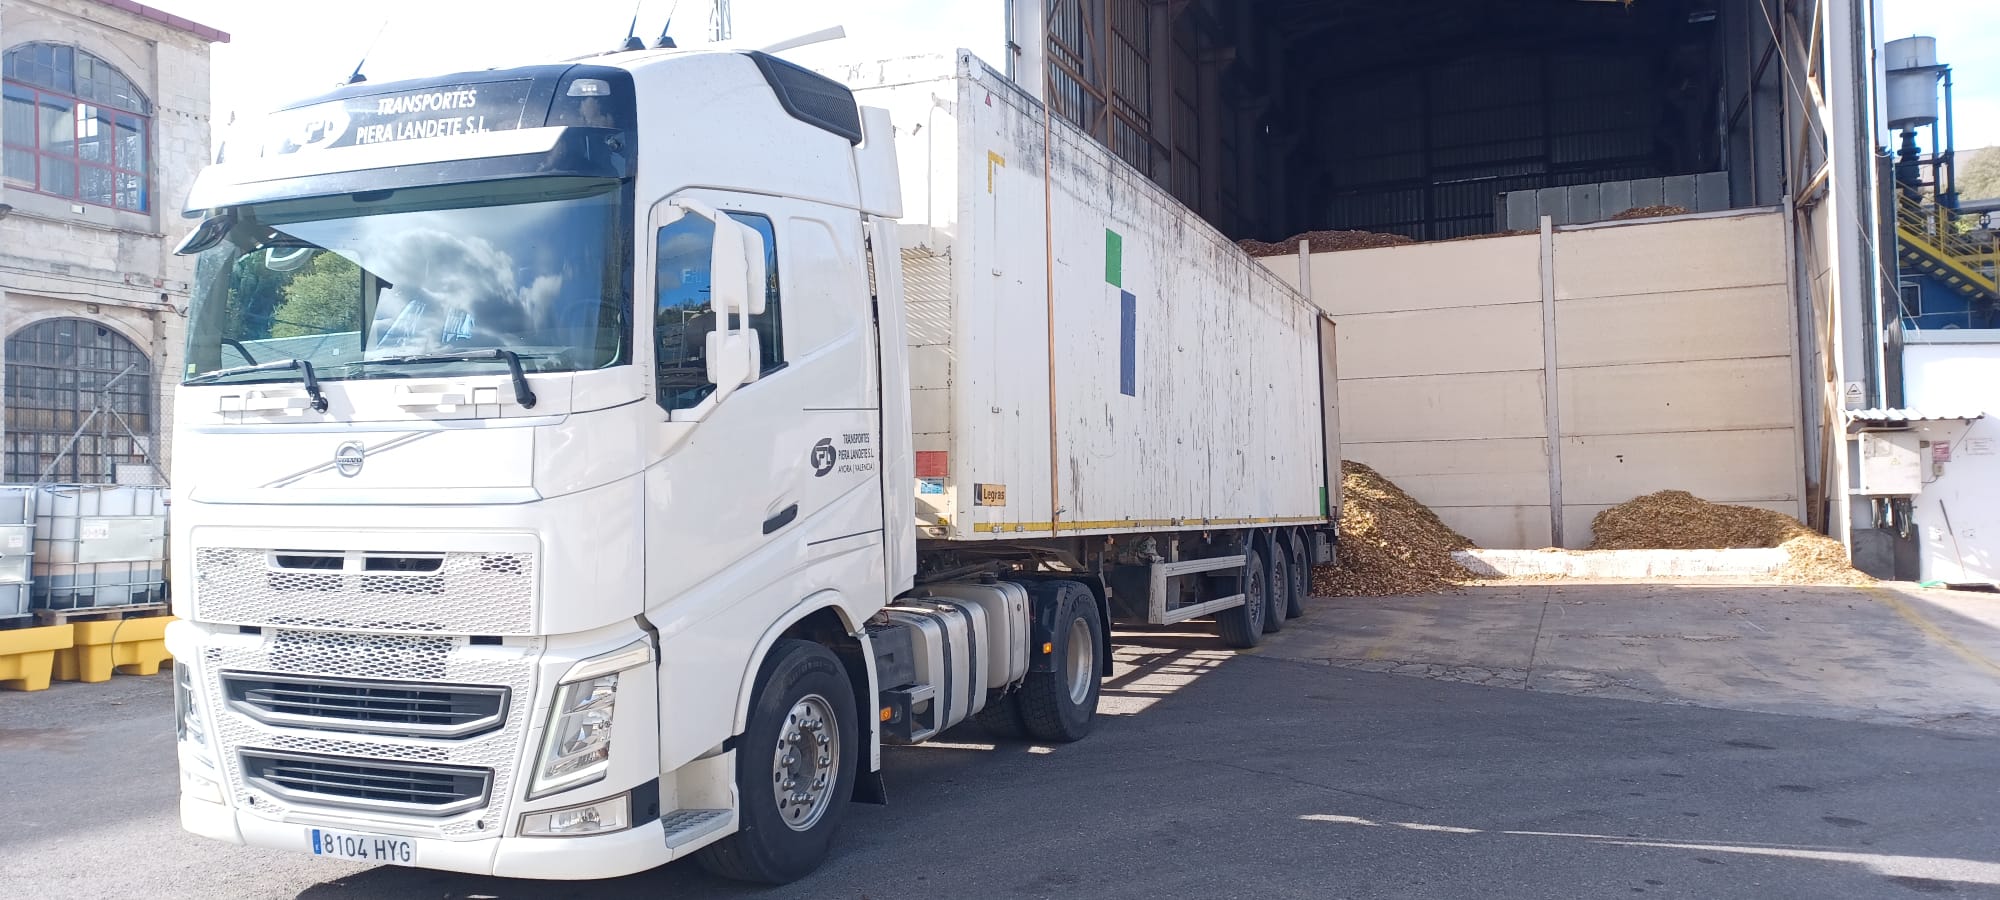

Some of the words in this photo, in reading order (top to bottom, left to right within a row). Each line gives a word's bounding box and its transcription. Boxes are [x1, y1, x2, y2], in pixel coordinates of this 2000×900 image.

[378, 90, 477, 115] TRANSPORTES
[356, 123, 393, 144] PIERA
[397, 118, 462, 141] LANDETE
[465, 116, 490, 134] S.L.
[843, 433, 870, 444] TRANSPORTES
[983, 488, 1005, 503] Legras
[324, 833, 368, 859] 8104
[374, 839, 411, 862] HYG
